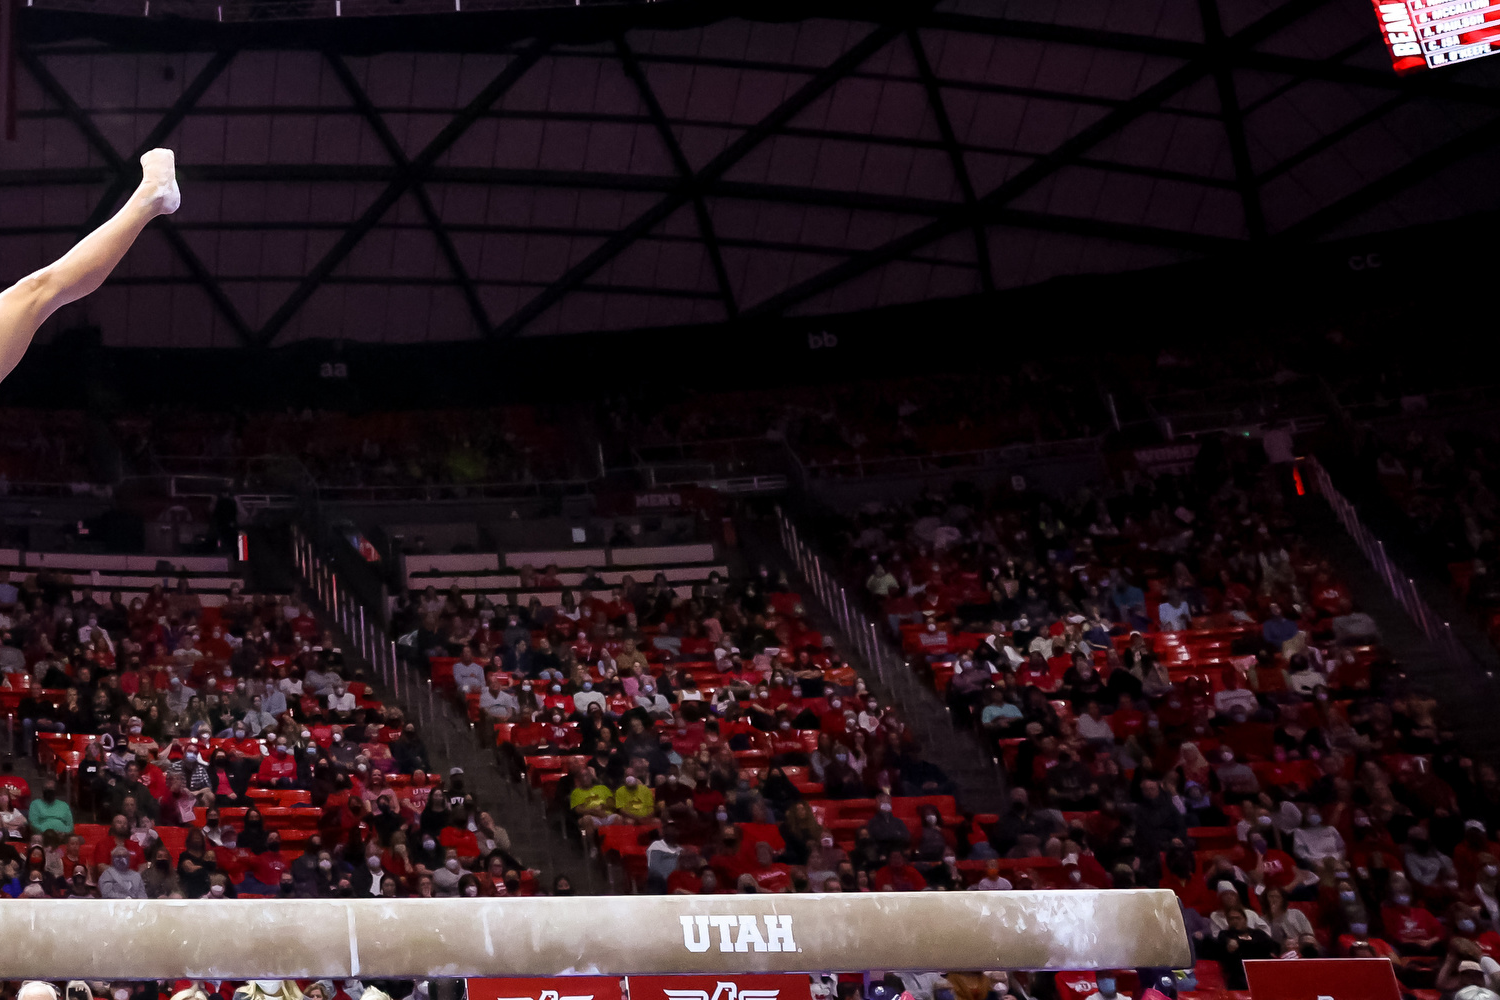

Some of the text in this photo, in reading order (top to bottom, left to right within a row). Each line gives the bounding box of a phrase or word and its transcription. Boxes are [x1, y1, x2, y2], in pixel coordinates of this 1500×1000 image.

[1378, 2, 1421, 57] BEAM
[1435, 14, 1485, 34] PAULSON
[1440, 36, 1461, 49] ISA
[1448, 44, 1491, 62] O'KEEFE
[680, 915, 797, 953] UTAH
